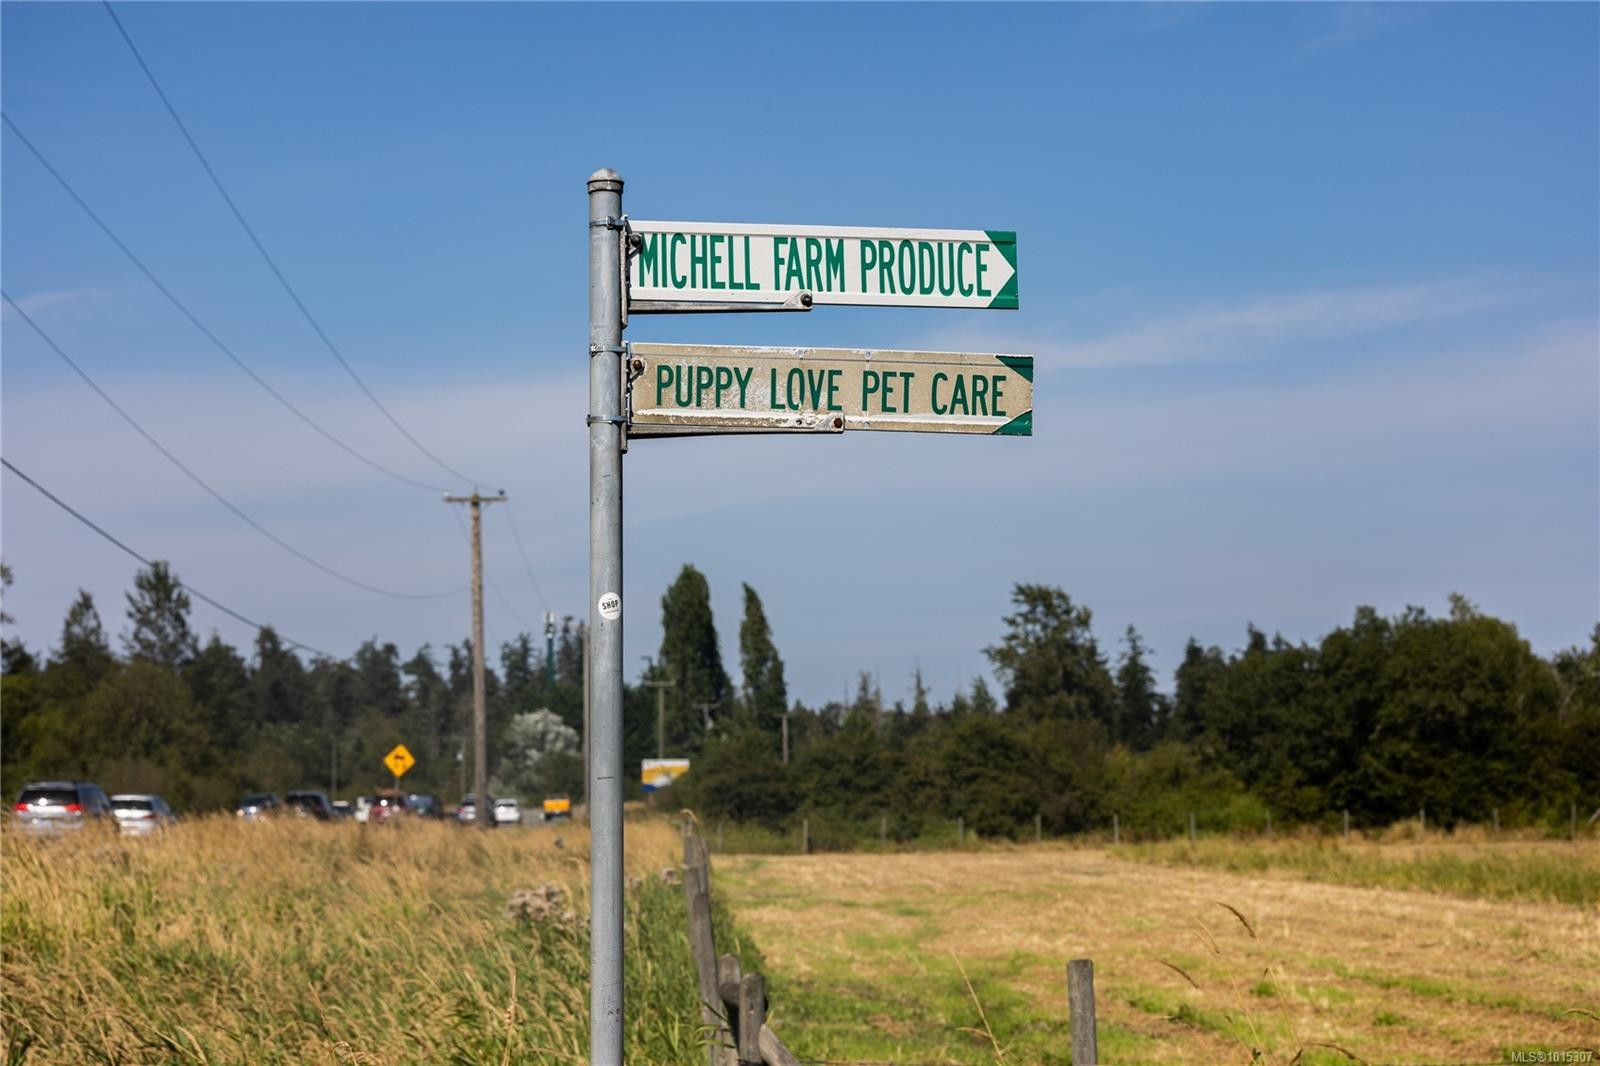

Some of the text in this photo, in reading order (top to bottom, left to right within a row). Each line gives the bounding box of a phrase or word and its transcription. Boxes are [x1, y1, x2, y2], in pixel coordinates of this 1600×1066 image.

[639, 232, 992, 297] MICHELL FARM PRODUCE
[656, 364, 1007, 417] PUPPY LOVE PET CARE
[602, 600, 618, 610] SHOP
